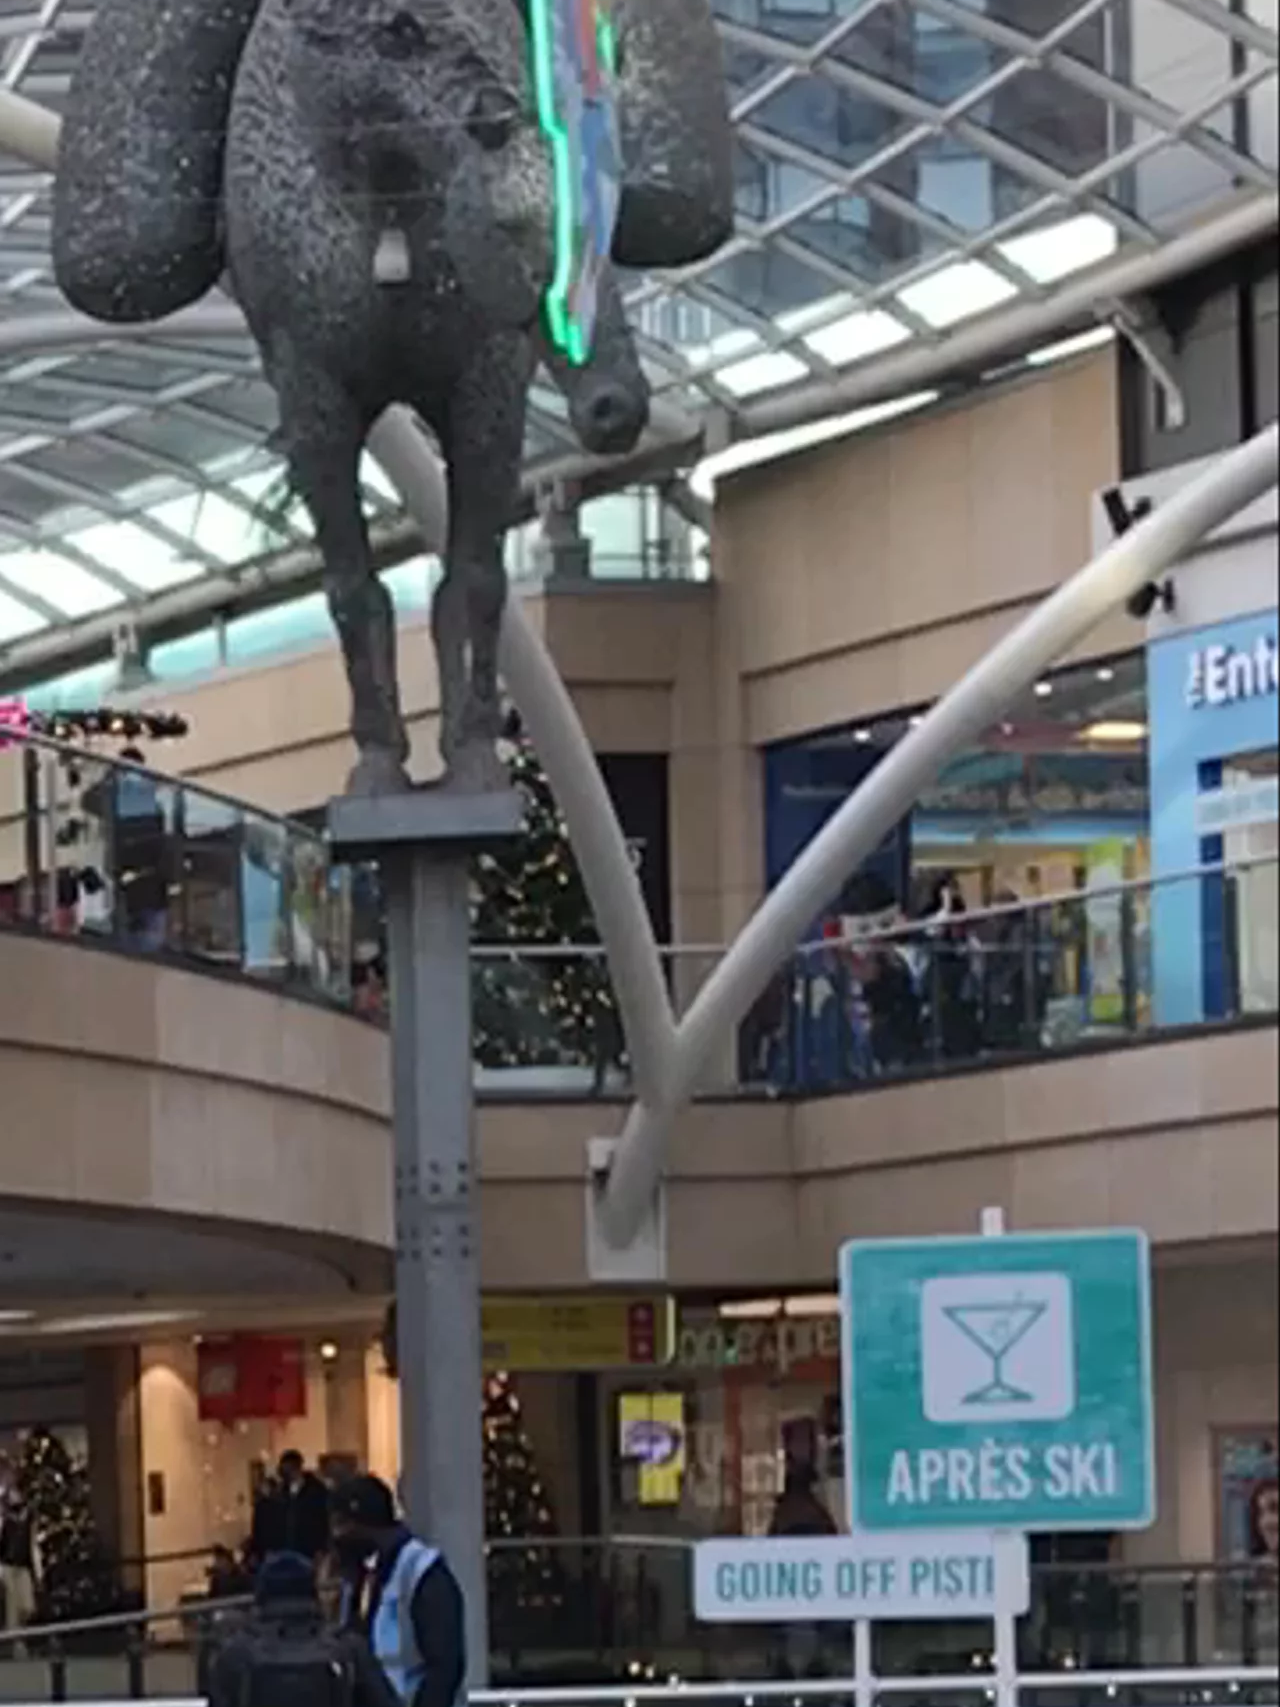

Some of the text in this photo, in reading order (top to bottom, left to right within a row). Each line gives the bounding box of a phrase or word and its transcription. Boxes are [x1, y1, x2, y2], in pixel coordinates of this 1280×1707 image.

[1043, 1442, 1117, 1500] SKI
[716, 1560, 823, 1602] GOING
[835, 1556, 897, 1598] OFF
